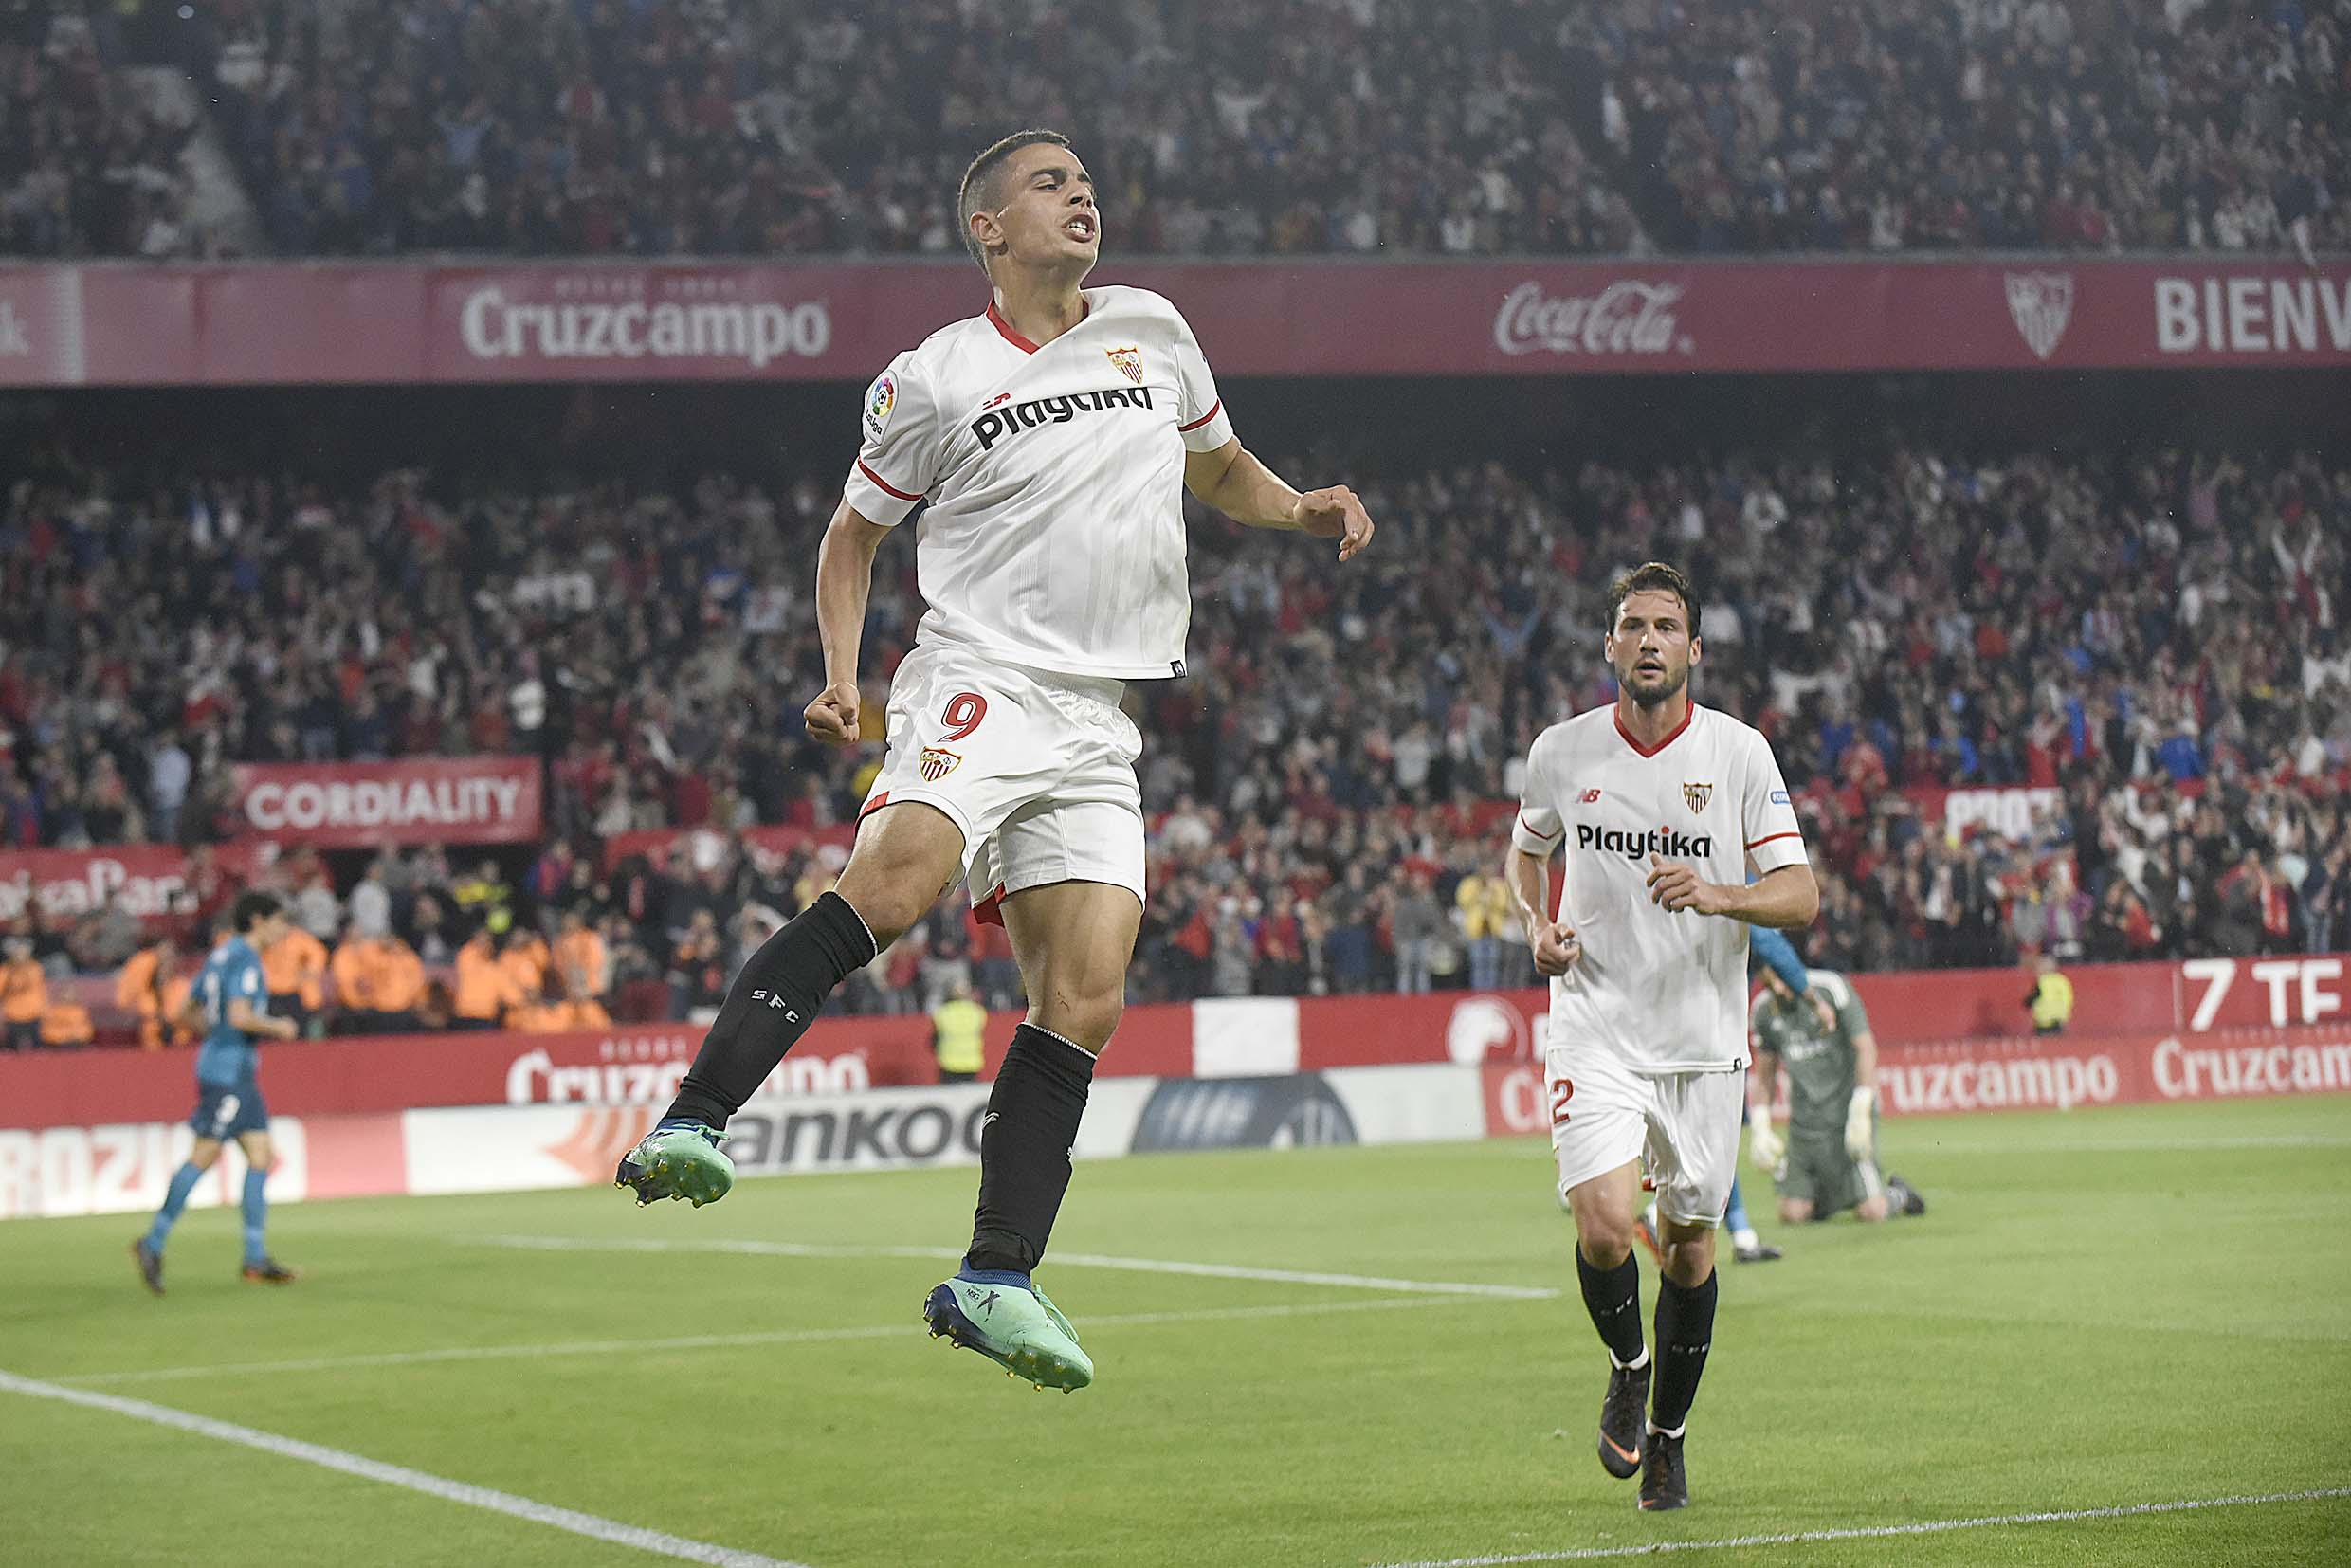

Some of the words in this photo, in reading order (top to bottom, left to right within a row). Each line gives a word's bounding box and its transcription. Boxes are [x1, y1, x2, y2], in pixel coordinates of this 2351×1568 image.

[462, 286, 832, 368] Cruzcampo
[2154, 276, 2351, 352] BIENV
[938, 692, 987, 742] 9
[245, 775, 520, 830] CORDIALITY
[1576, 824, 1711, 860] Playtika
[2183, 958, 2235, 1031] 7
[1552, 1078, 1574, 1124] 2
[1876, 1055, 2118, 1112] ruzcampo
